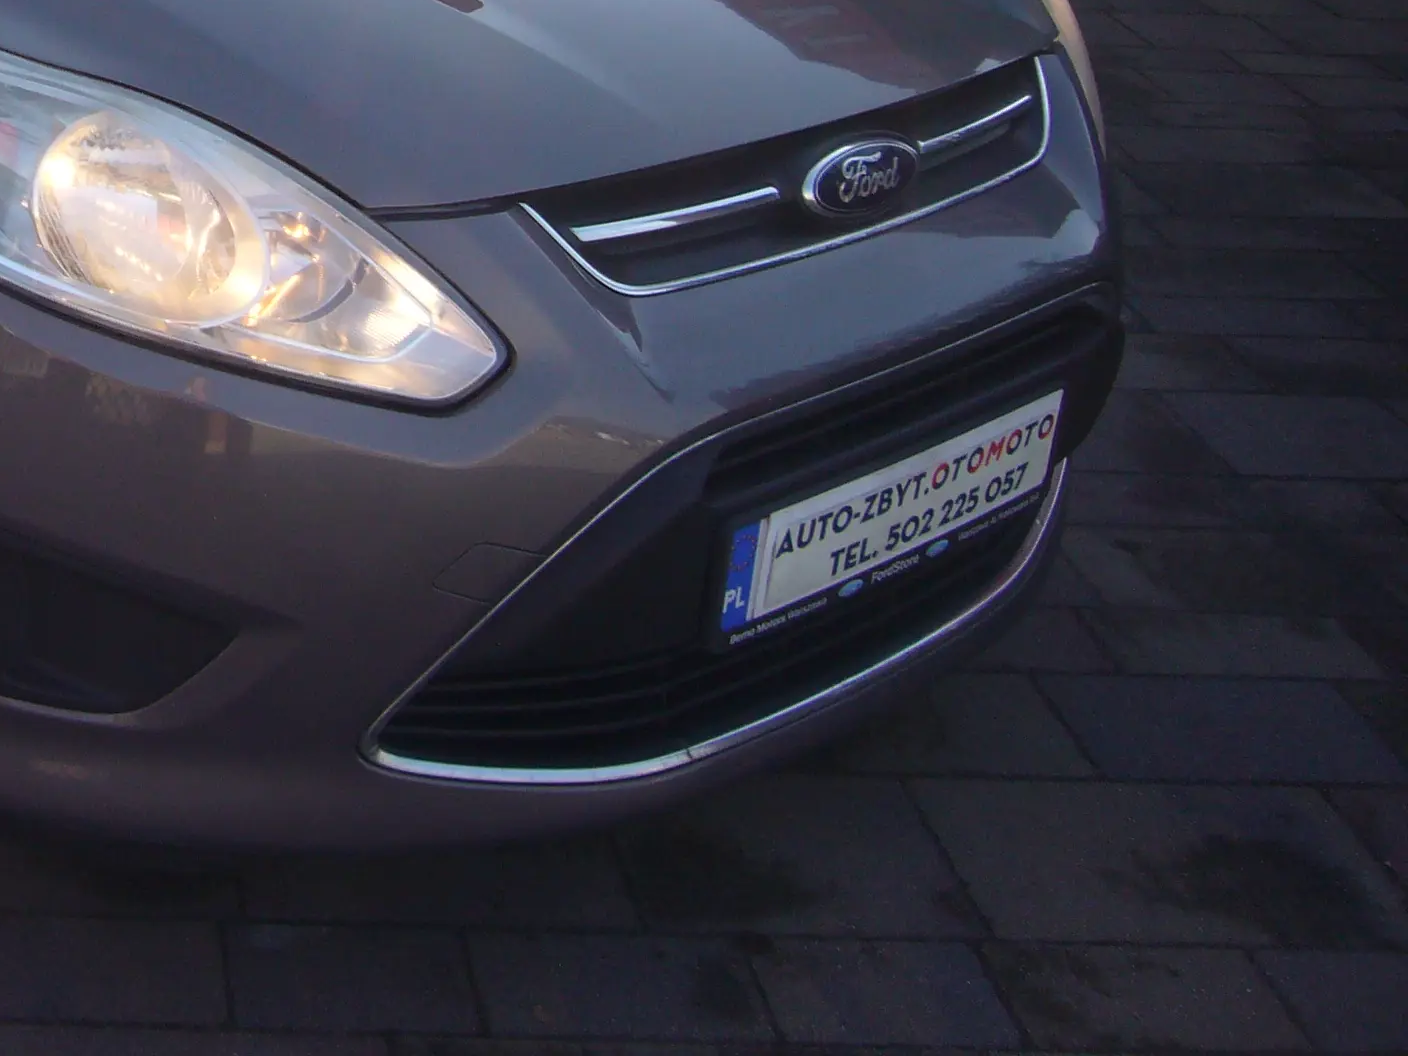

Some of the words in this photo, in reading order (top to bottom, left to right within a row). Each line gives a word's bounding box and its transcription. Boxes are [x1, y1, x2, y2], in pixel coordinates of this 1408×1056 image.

[838, 150, 900, 204] Ford
[776, 412, 1055, 559] AUTO-ZBYT.OTOMOTO
[829, 538, 879, 577] TEL.
[886, 507, 935, 552] 502
[937, 485, 980, 528] 225
[984, 461, 1030, 504] 057
[722, 586, 746, 615] PL
